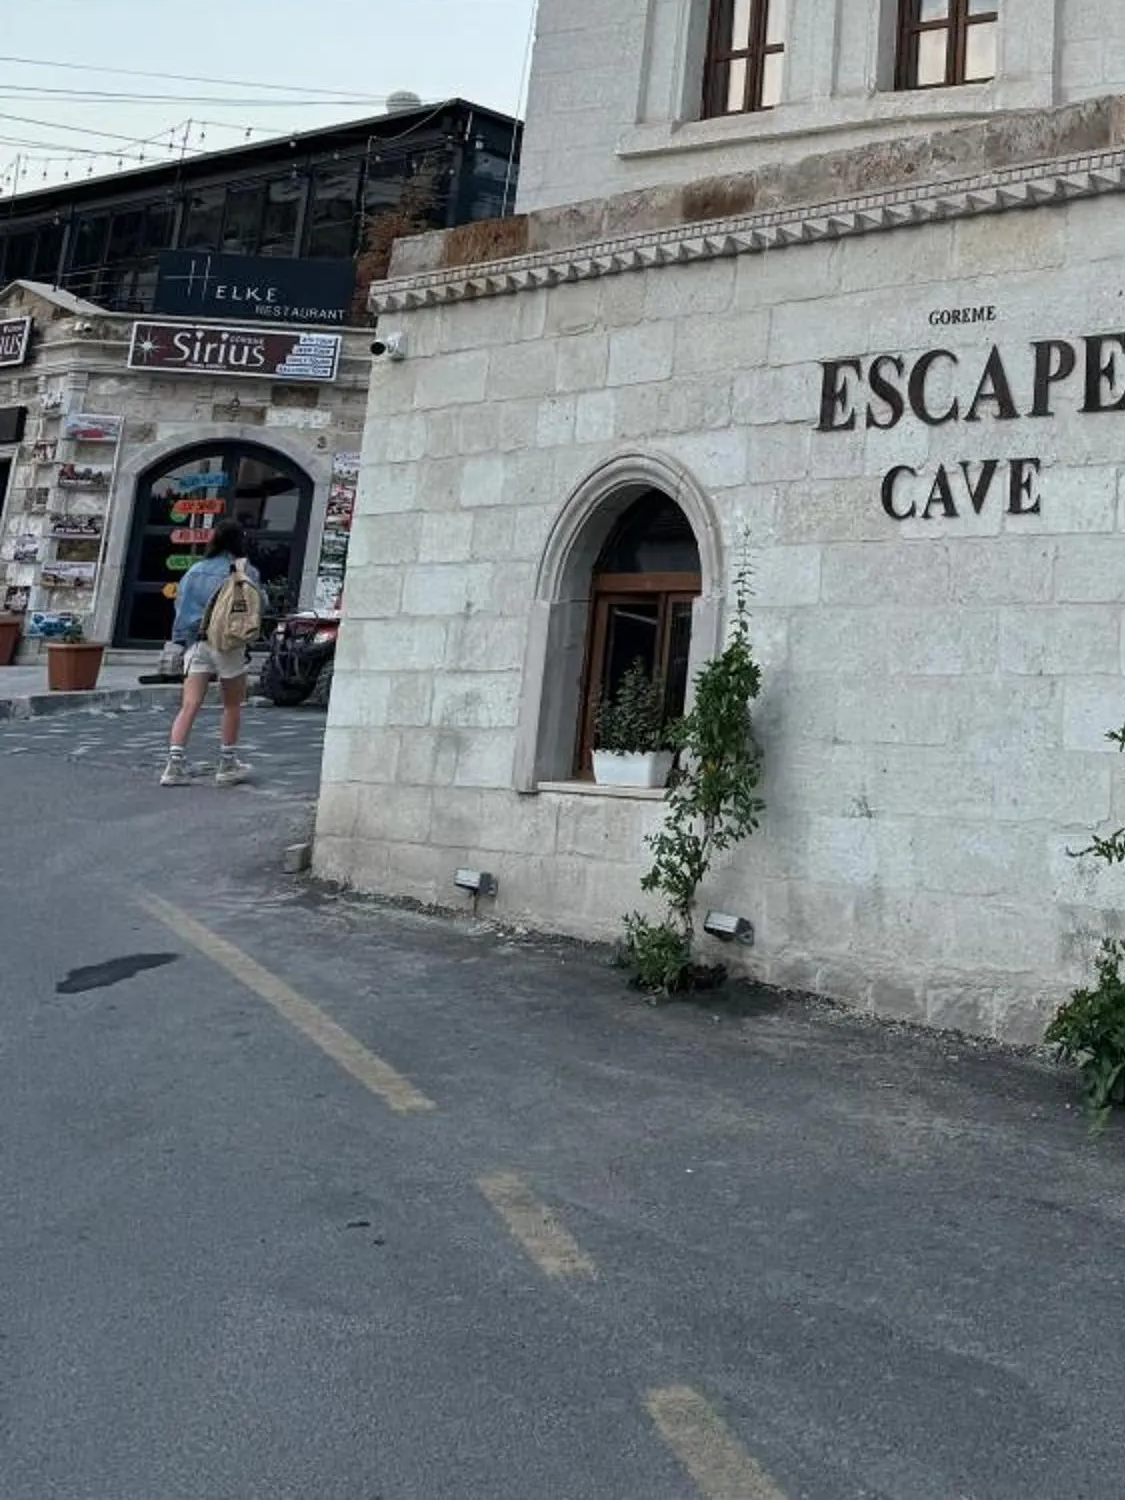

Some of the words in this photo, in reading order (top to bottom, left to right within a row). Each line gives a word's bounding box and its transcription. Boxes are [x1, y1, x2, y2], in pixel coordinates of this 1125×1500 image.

[254, 303, 347, 321] RESTAURANT
[164, 330, 265, 368] Sirius
[880, 457, 1041, 520] CAVE
